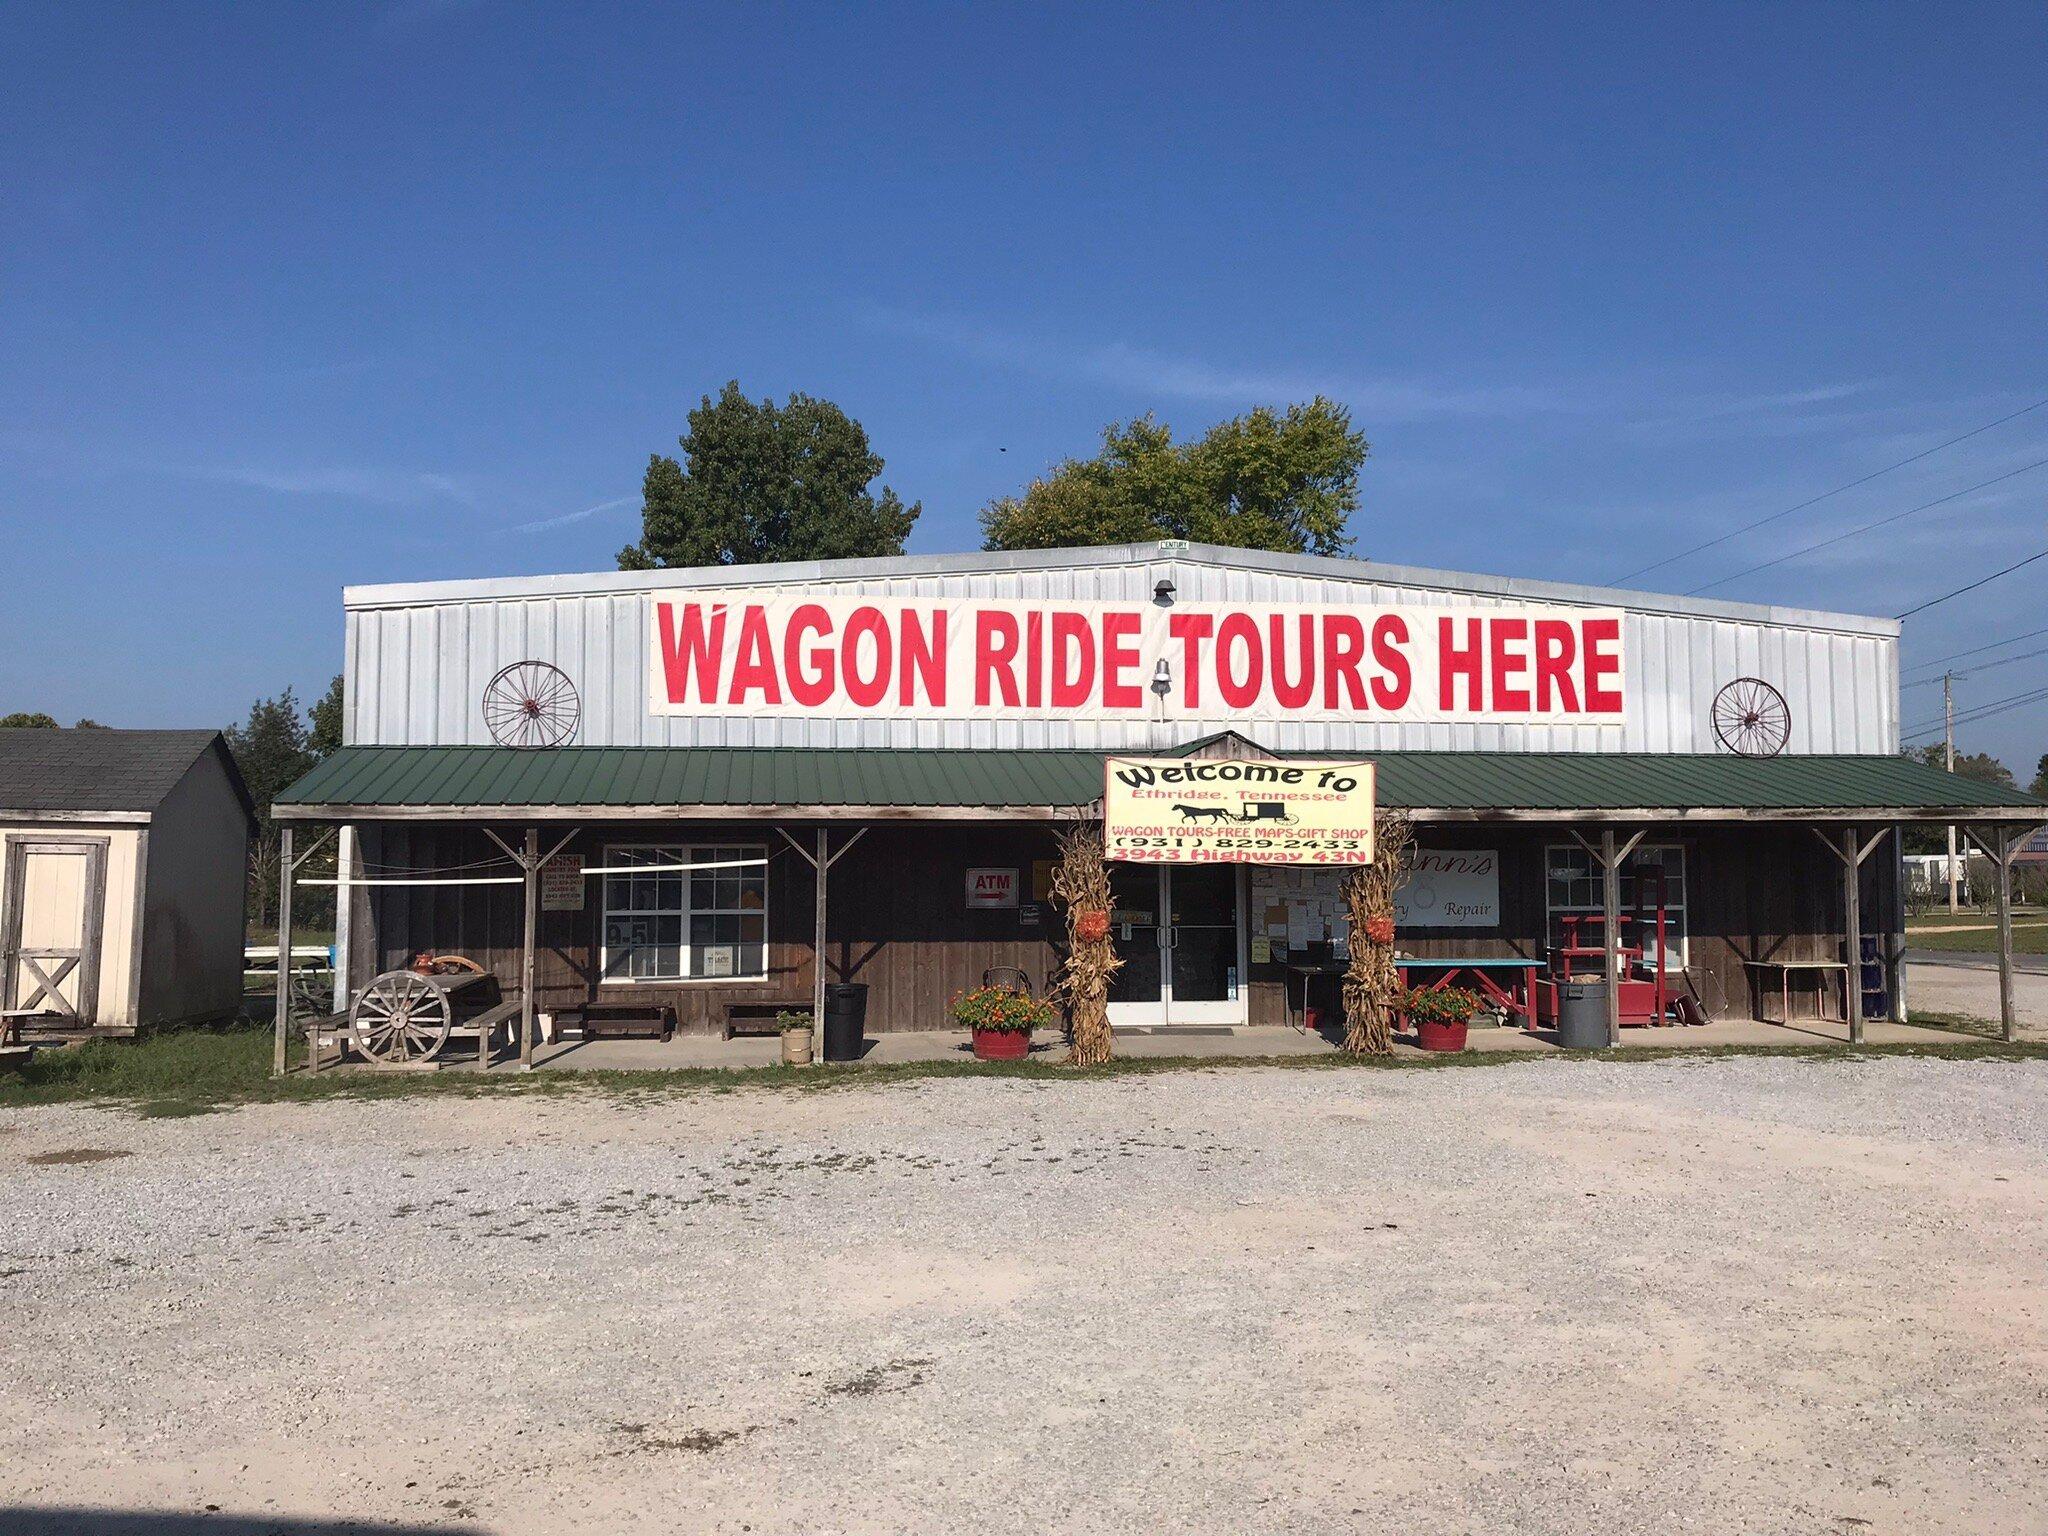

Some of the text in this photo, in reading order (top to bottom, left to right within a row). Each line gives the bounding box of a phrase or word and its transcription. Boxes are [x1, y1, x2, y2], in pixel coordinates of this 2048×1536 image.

[1161, 541, 1187, 549] CENTURY
[656, 602, 1623, 713] WAGON RIDE TOURS HERE
[1115, 761, 1358, 793] Welcome to
[1236, 790, 1347, 801] Tennessee
[1111, 826, 1163, 837] WAGON
[1331, 828, 1369, 839] SHOP
[1115, 837, 1359, 849] (931) 829-2433
[1112, 848, 1366, 862] 3943 Highway 43N
[1400, 855, 1492, 876] ann's
[975, 875, 1011, 889] ATM
[1444, 902, 1492, 922] Repair
